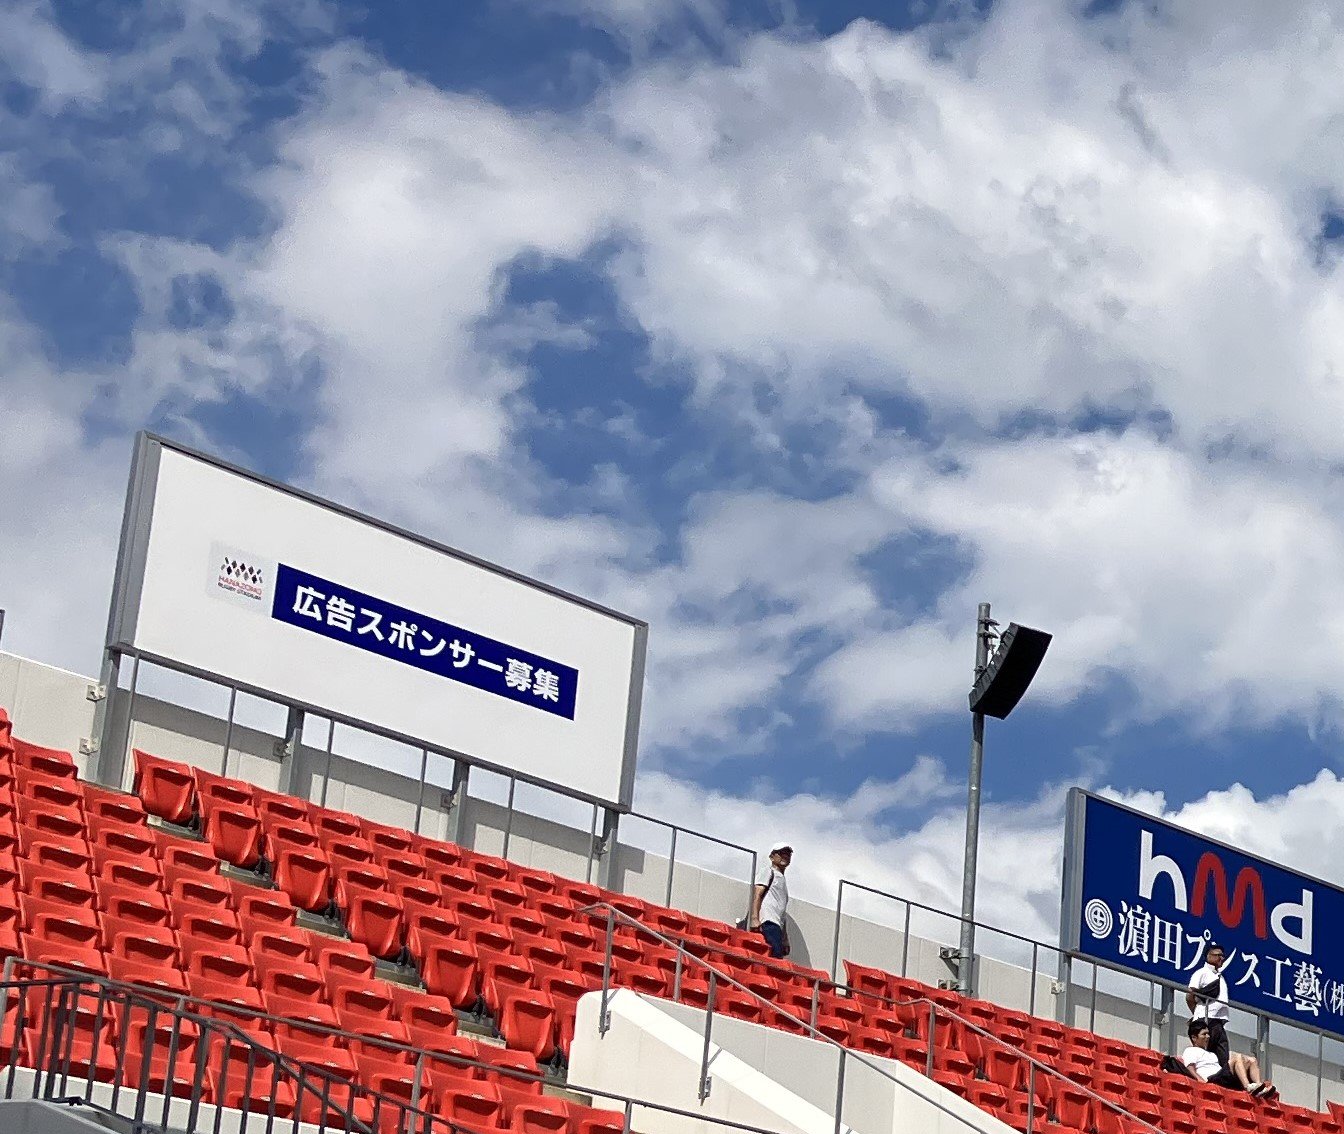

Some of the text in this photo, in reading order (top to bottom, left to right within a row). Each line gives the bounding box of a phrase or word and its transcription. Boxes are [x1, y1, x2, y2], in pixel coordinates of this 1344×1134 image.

[292, 584, 560, 703] 広告スポンサー募集
